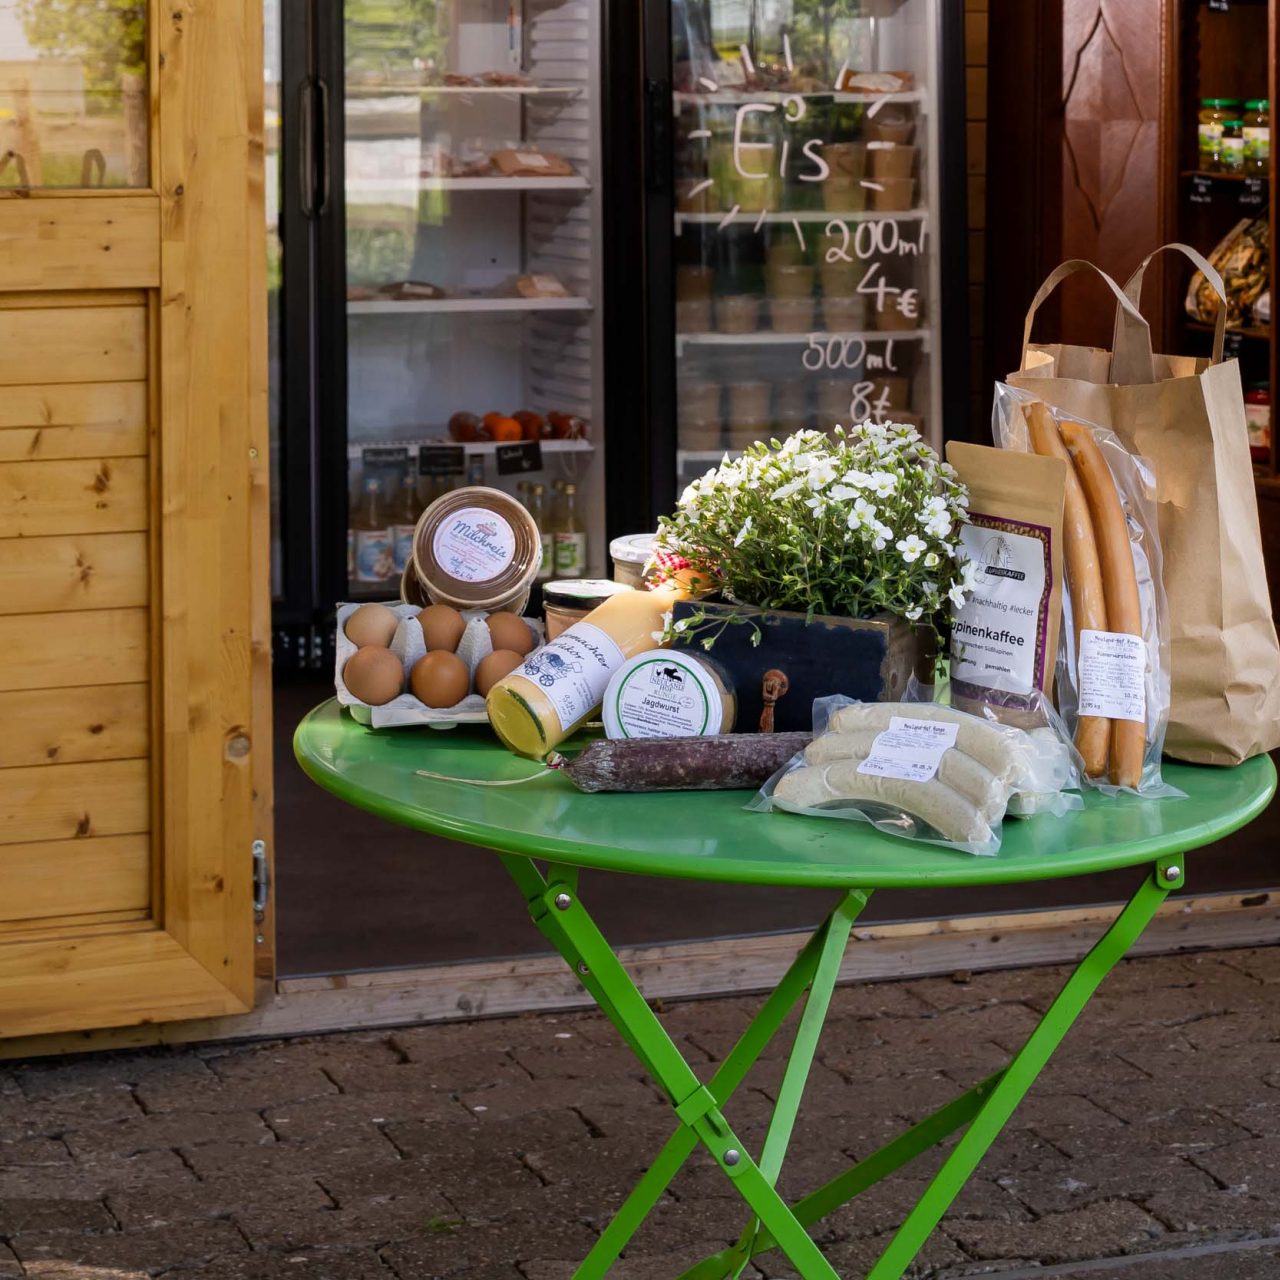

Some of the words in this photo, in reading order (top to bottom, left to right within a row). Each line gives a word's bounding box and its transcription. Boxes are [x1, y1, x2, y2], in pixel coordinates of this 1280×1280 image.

[733, 94, 830, 182] Eis
[452, 520, 507, 559] Milchreis
[972, 596, 1008, 612] #nachhaltig
[1009, 605, 1034, 616] #lecker
[951, 620, 1025, 646] upinenkaffee
[641, 696, 680, 714] Jagdwurst
